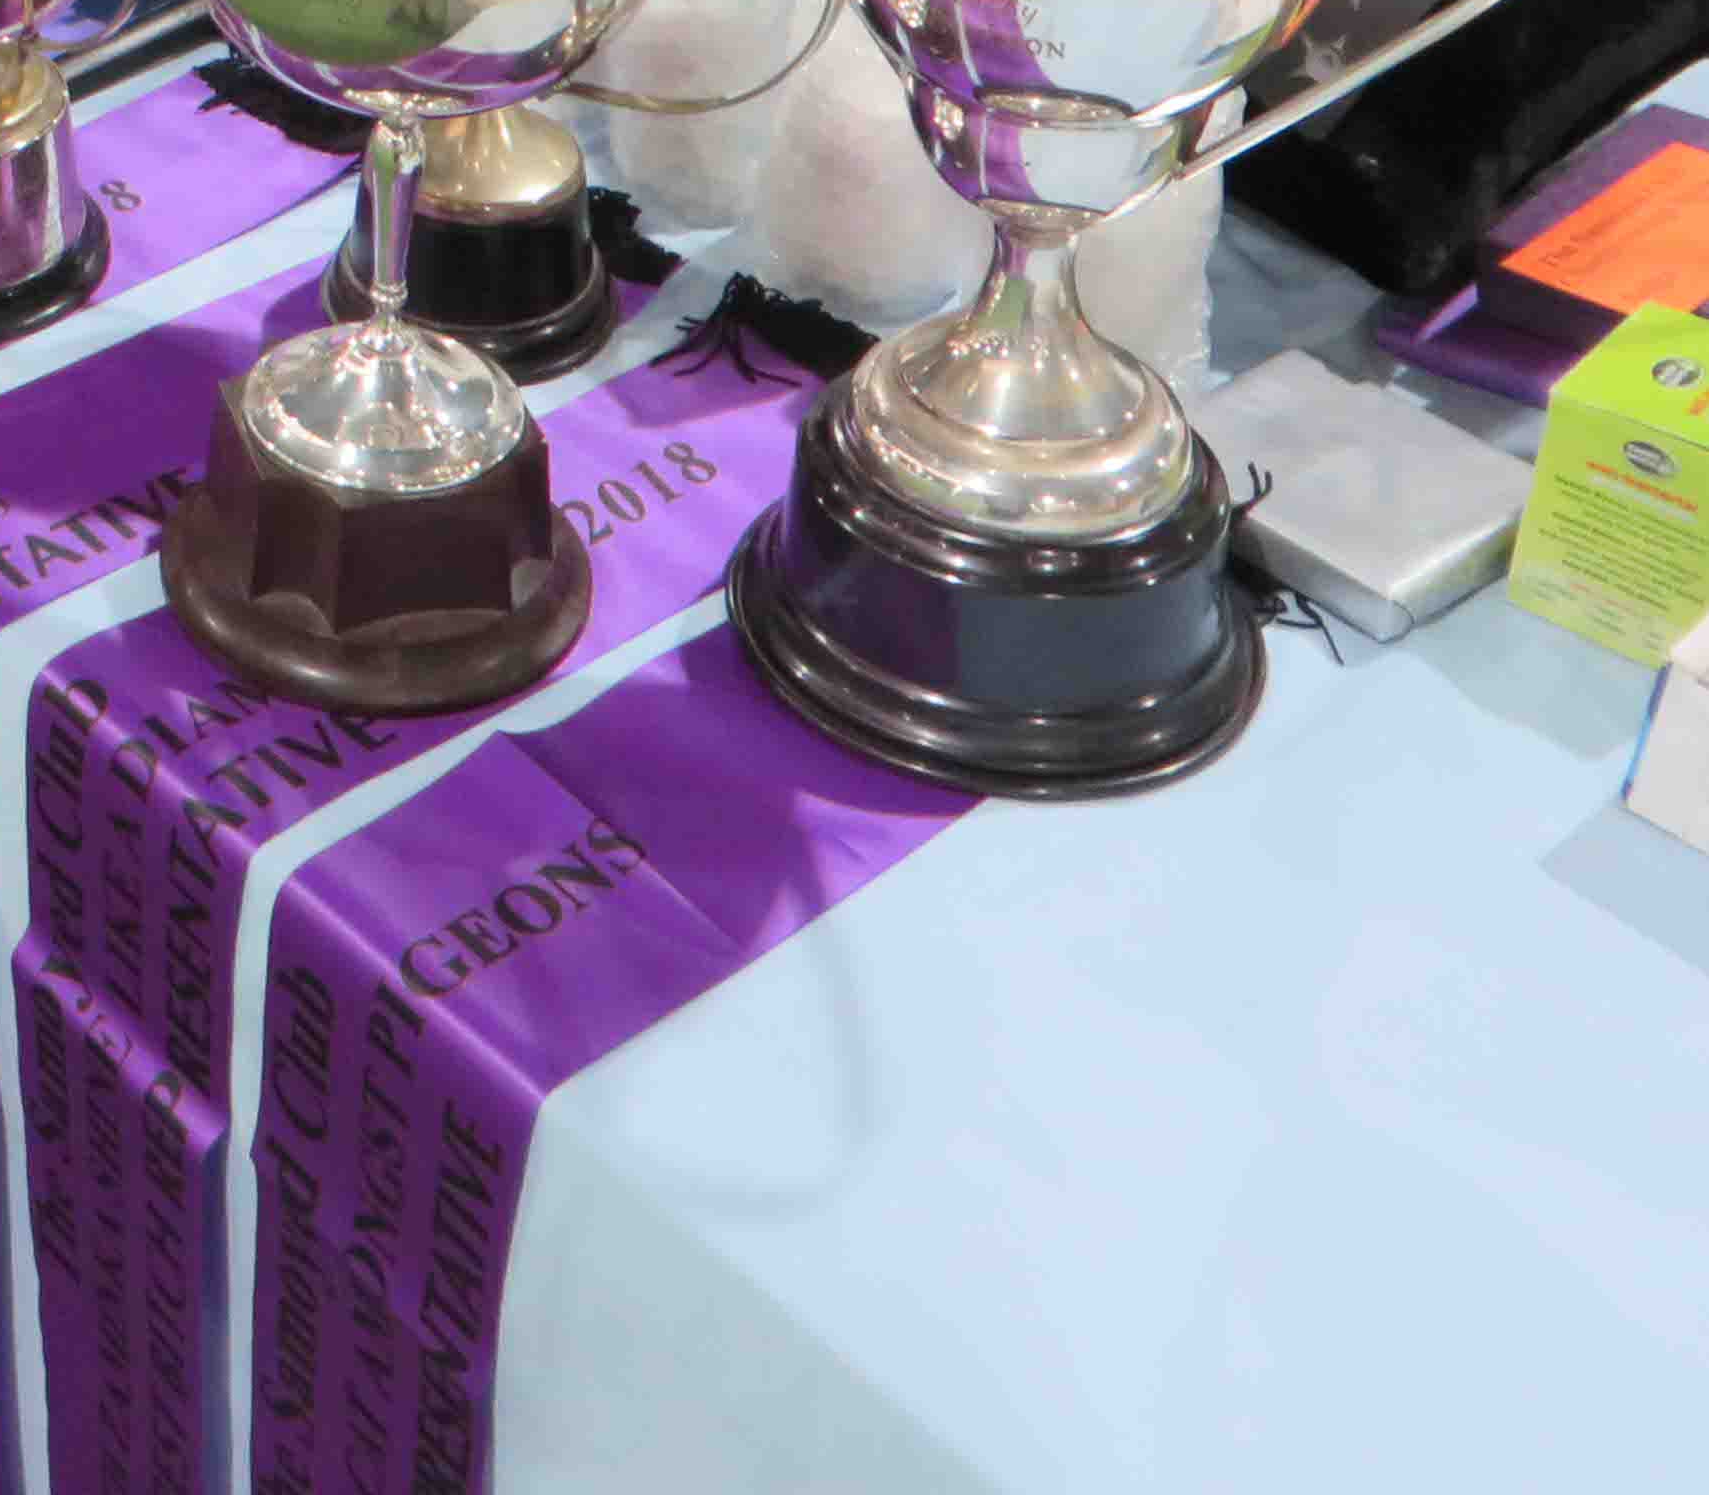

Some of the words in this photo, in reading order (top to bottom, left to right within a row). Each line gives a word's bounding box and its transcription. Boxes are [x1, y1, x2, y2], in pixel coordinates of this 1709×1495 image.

[559, 439, 720, 546] 2018
[31, 675, 109, 850] Club
[142, 707, 399, 1207] REPRESENTATIVE
[271, 966, 337, 1142] Club
[364, 813, 649, 1080] PIGEONS
[259, 1136, 337, 1419] Samoyed
[346, 1066, 410, 1403] AMONGST
